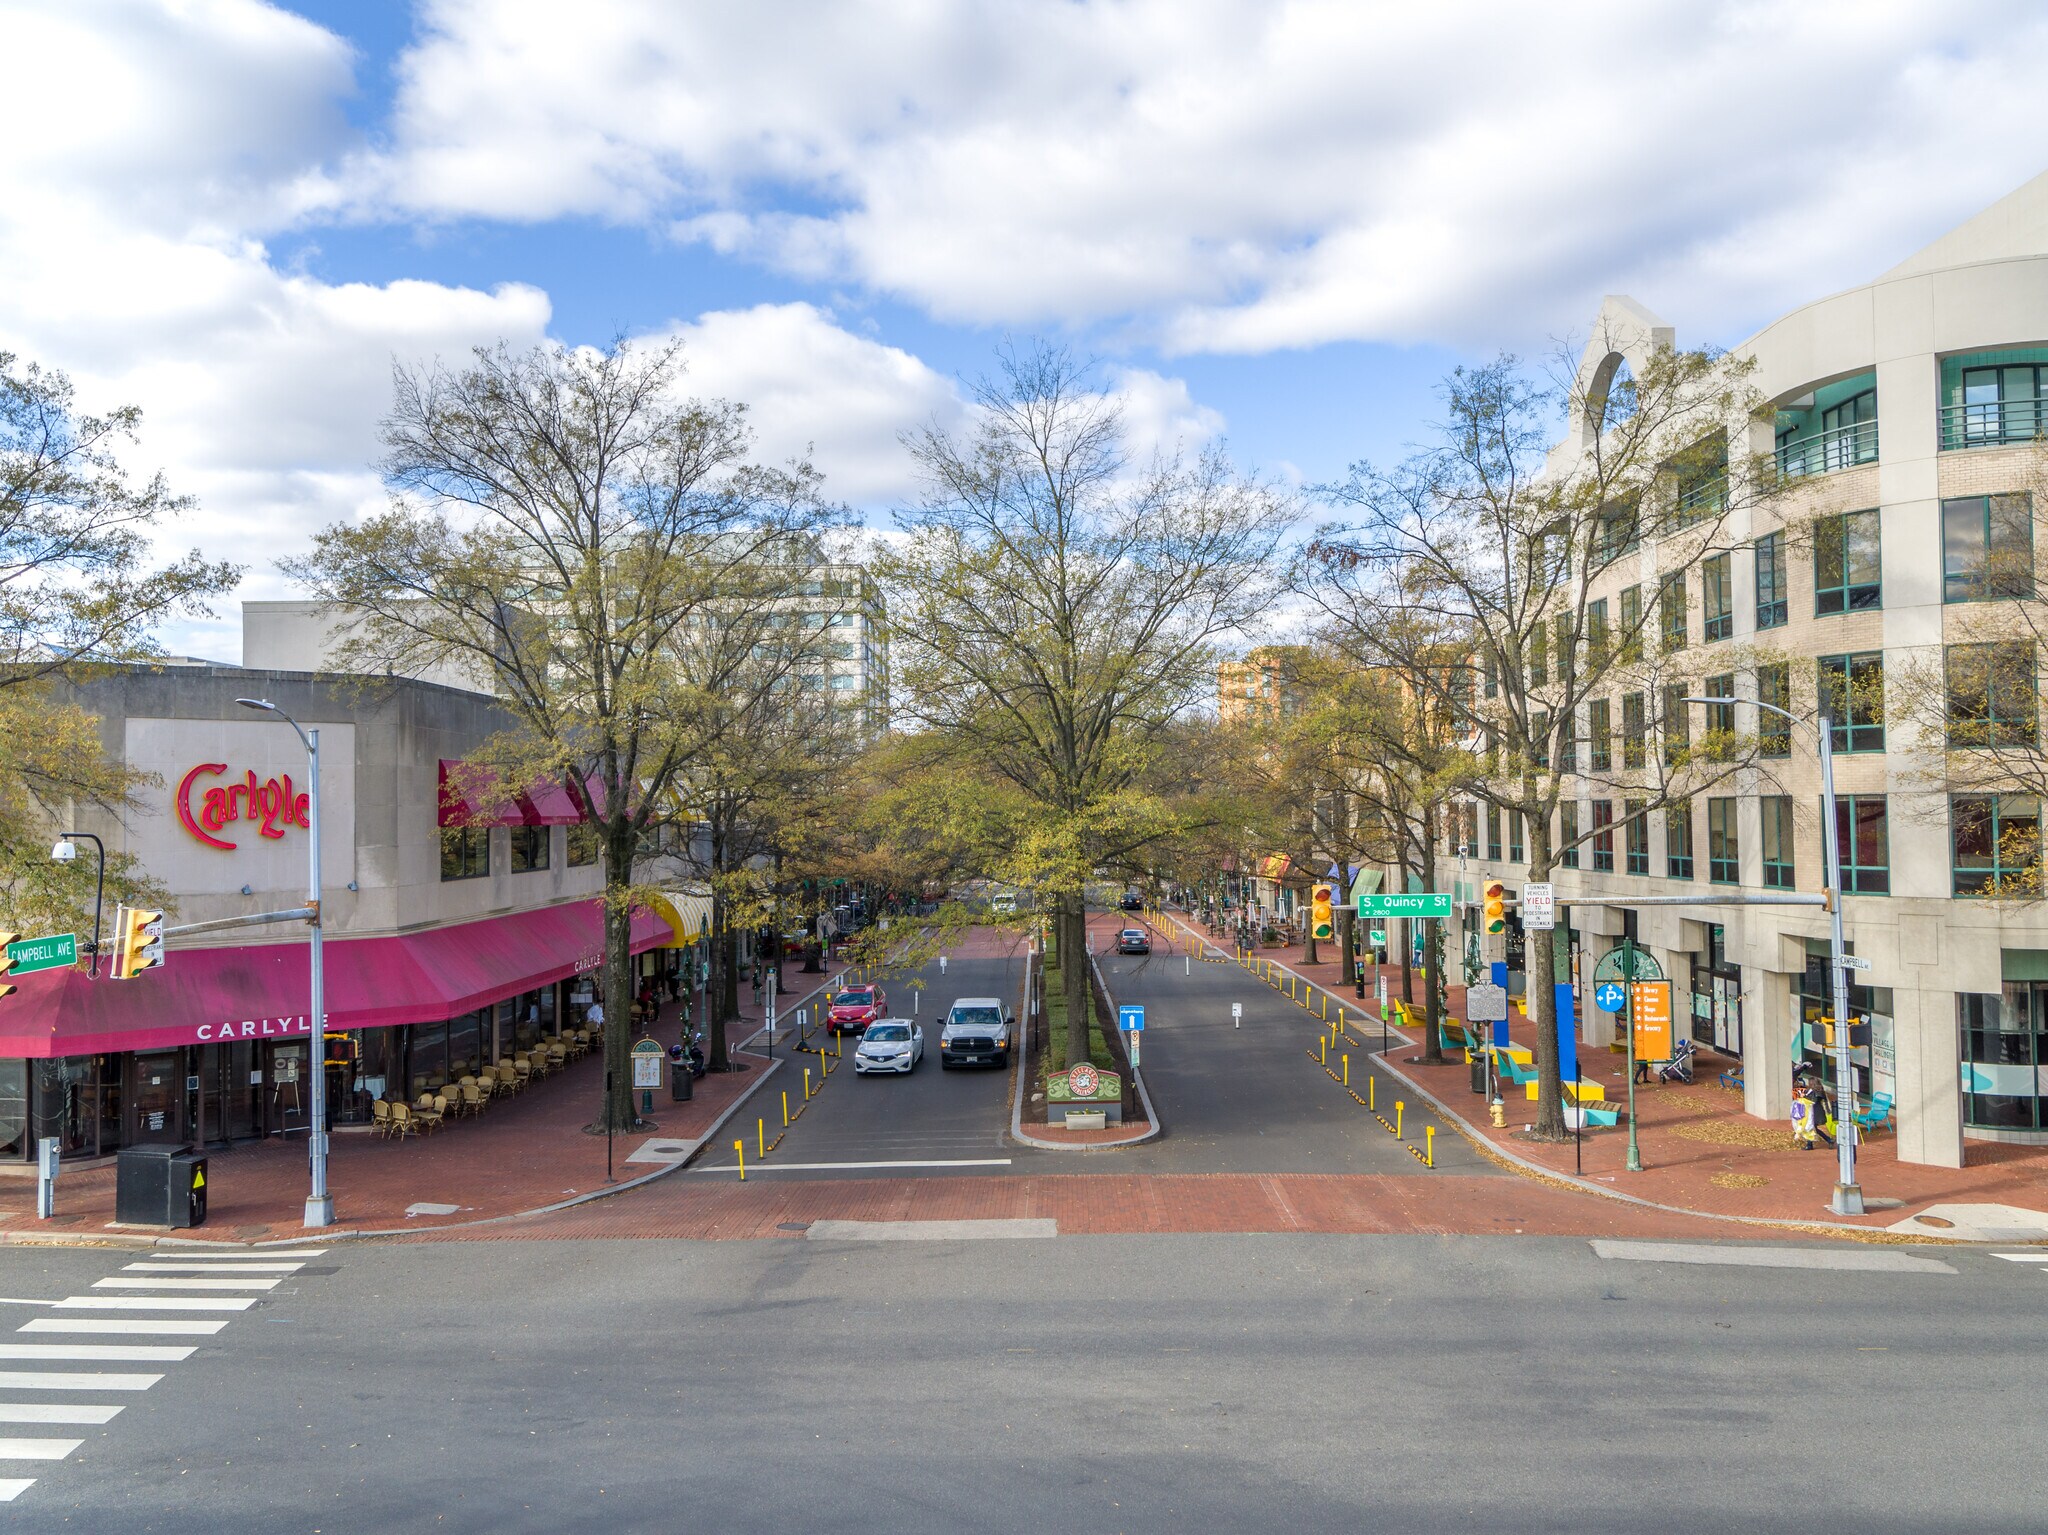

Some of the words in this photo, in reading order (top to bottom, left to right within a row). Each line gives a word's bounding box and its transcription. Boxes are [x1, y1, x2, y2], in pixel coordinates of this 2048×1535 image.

[174, 763, 310, 850] Carlyle
[1363, 897, 1374, 907] S.
[1384, 896, 1424, 909] Quincy
[1434, 896, 1446, 906] St
[11, 946, 54, 962] CAMPBELL
[58, 942, 72, 956] AVE
[574, 954, 600, 972] CARLYLE
[1606, 990, 1617, 1005] P
[197, 1014, 328, 1040] CARLYLE
[1644, 1024, 1662, 1032] Grocery
[1072, 1068, 1096, 1078] VILLAGE
